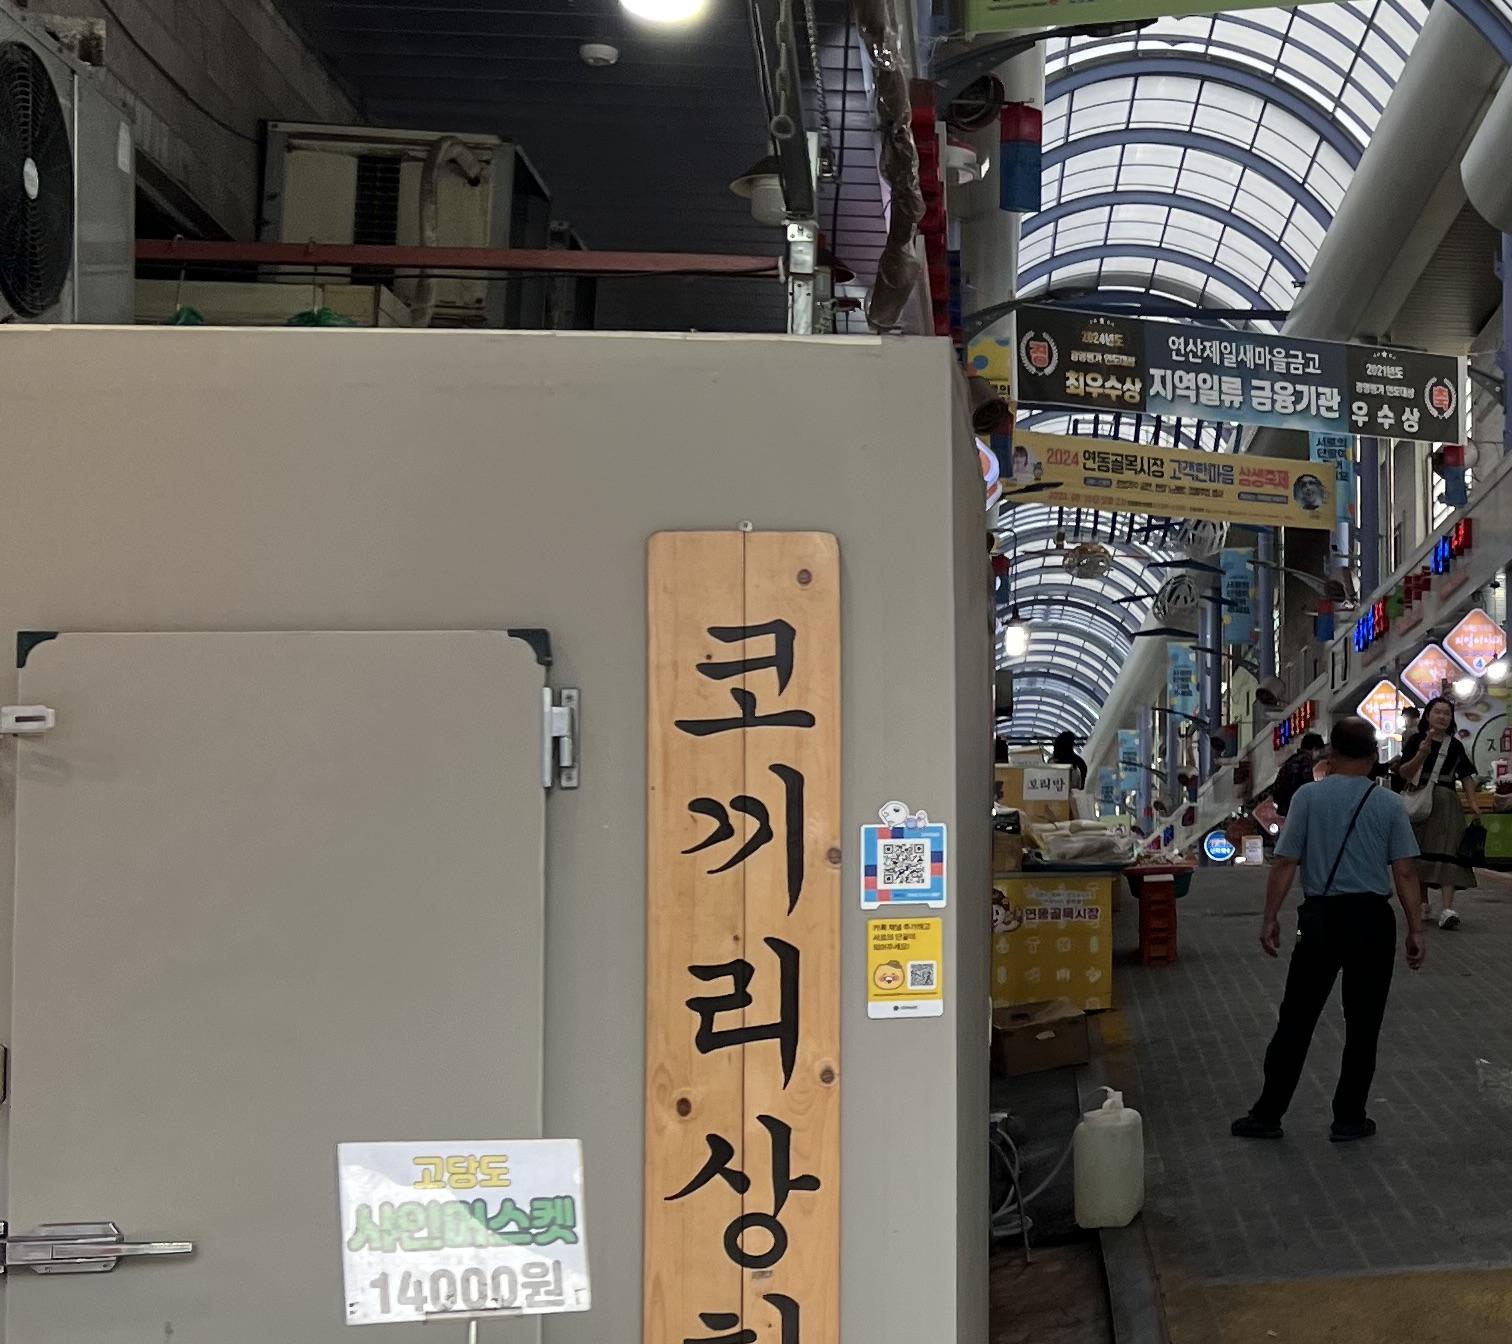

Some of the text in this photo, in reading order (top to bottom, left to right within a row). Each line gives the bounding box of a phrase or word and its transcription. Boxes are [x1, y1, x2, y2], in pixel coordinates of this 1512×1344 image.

[1168, 335, 1322, 375] 연산제일새마을금고
[1065, 369, 1143, 404] 최우수상
[1149, 367, 1341, 419] 지역일류 금융기관
[1047, 448, 1079, 467] 2024
[1083, 449, 1165, 478] 연동골목시장
[413, 1154, 512, 1190] 고당도
[347, 1194, 578, 1252] 샤인머스켓
[369, 1259, 566, 1315] 14000원
